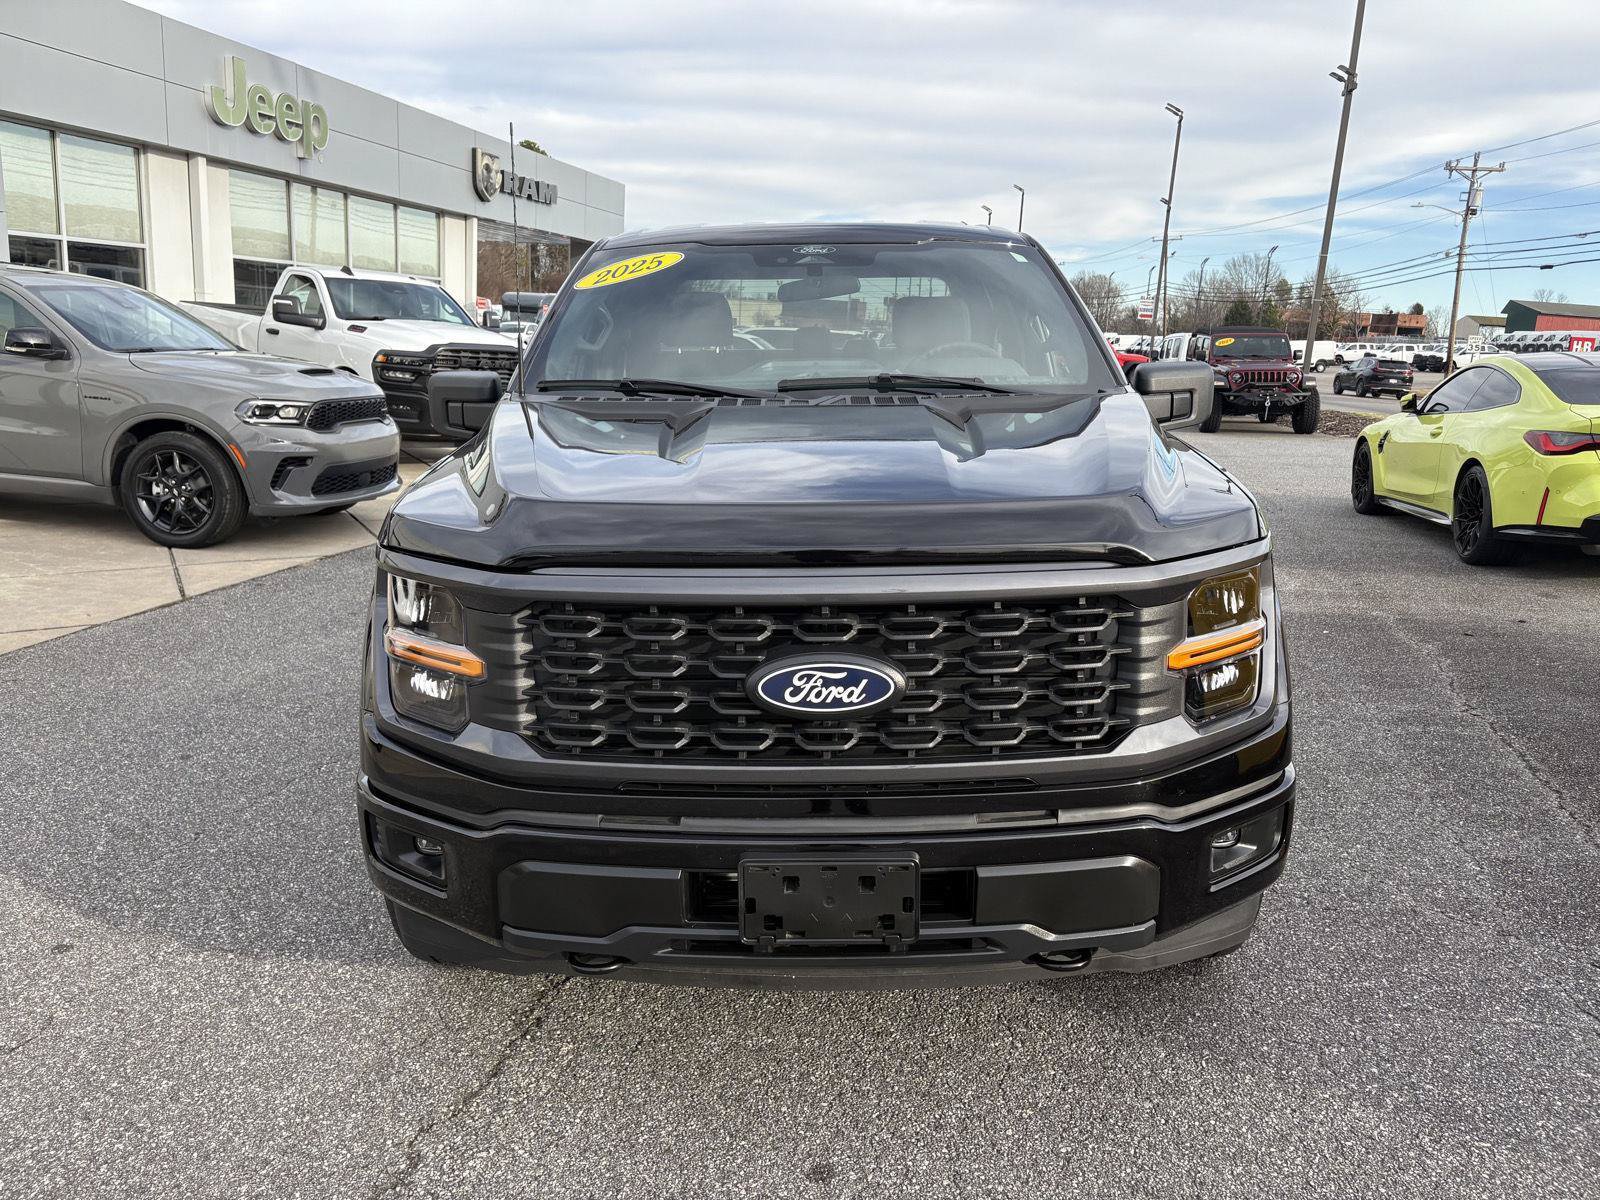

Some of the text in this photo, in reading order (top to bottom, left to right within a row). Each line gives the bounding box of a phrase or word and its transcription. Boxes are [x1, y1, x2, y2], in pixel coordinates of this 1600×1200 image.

[203, 56, 329, 160] Jeep
[500, 170, 557, 204] RAM
[593, 255, 665, 285] 2025
[784, 670, 868, 703] Ford
